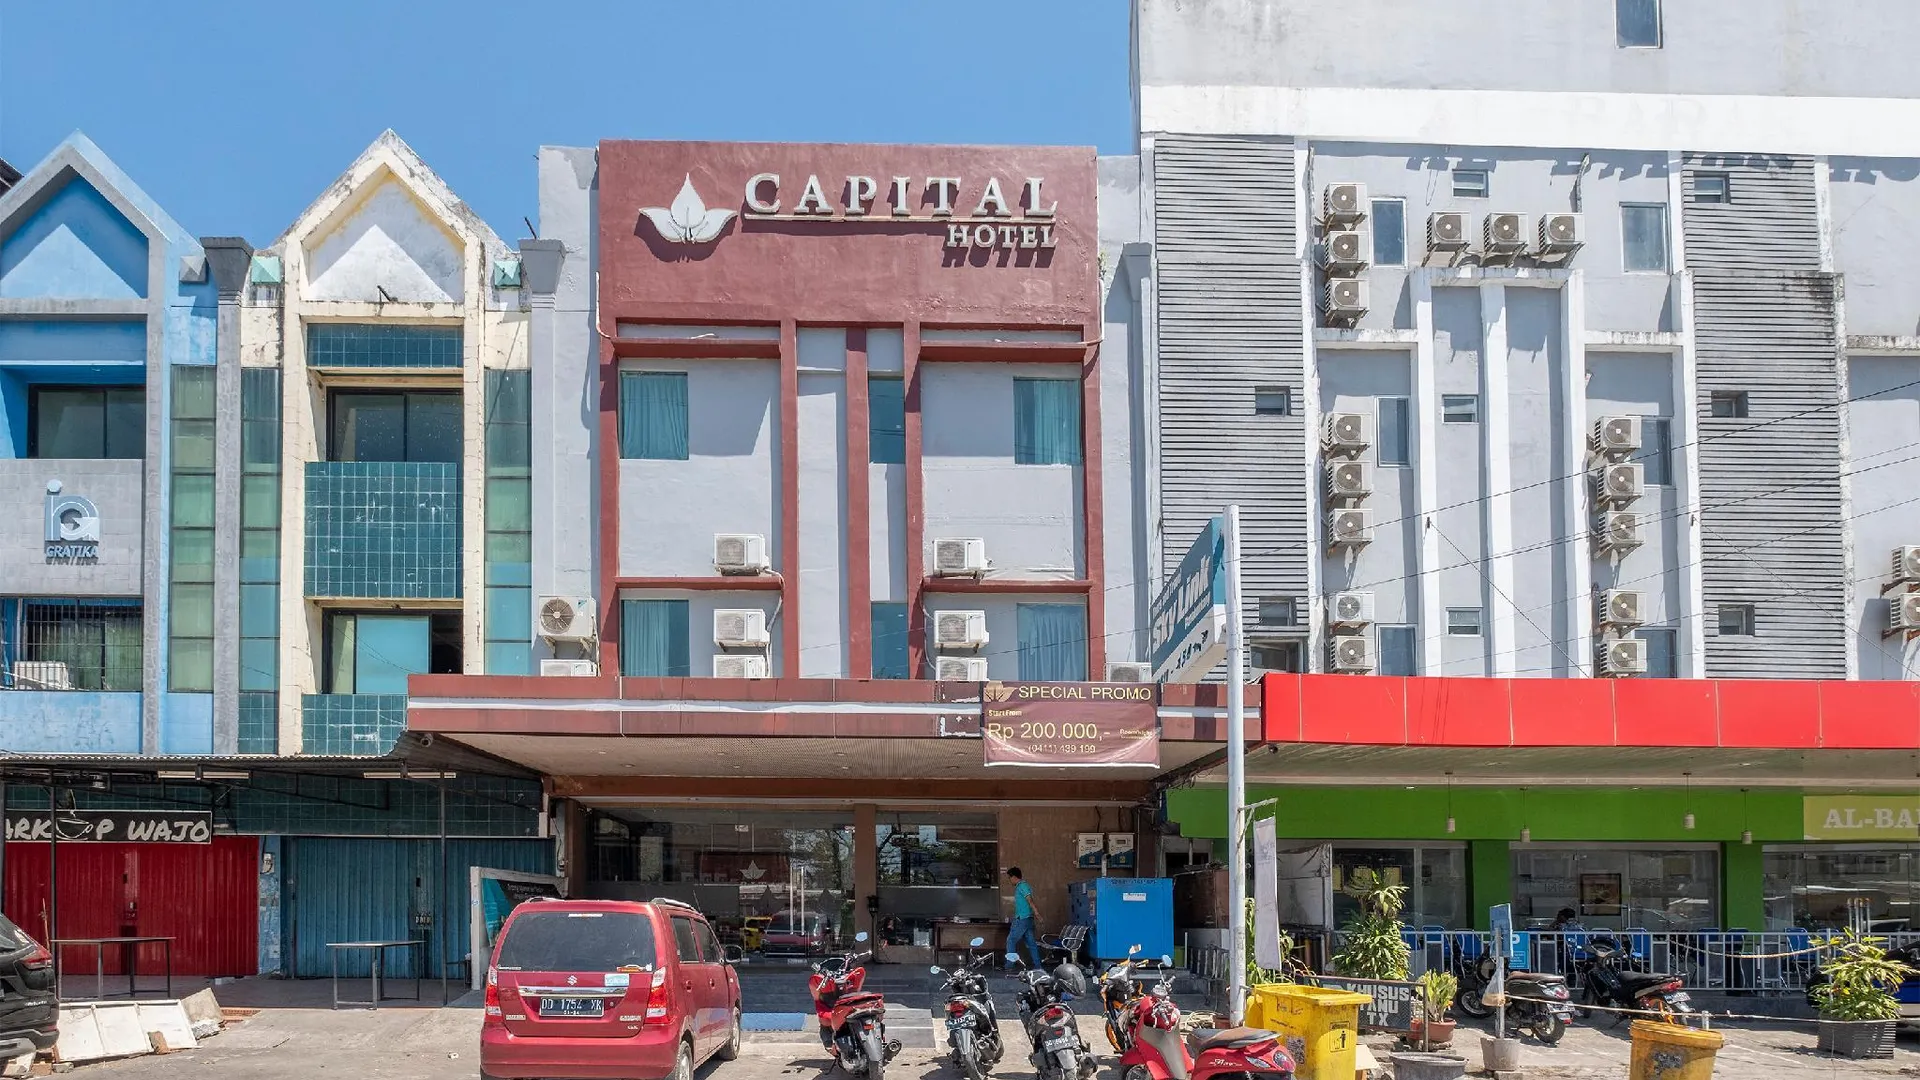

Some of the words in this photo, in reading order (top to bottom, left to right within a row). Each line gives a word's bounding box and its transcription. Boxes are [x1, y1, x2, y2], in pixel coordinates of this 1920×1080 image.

[745, 173, 1058, 215] CAPITAL
[947, 224, 1059, 248] HOTEL
[46, 545, 99, 558] GRATIKA
[1018, 685, 1087, 699] SPECIAL
[1091, 687, 1151, 701] PROMO
[988, 722, 1015, 742] Rp
[1020, 722, 1111, 742] 200.000,-
[1028, 744, 1058, 754] (0411)
[1823, 808, 1920, 829] AL-BA
[127, 819, 210, 842] WAJO
[541, 998, 554, 1010] DD
[590, 999, 602, 1010] XK
